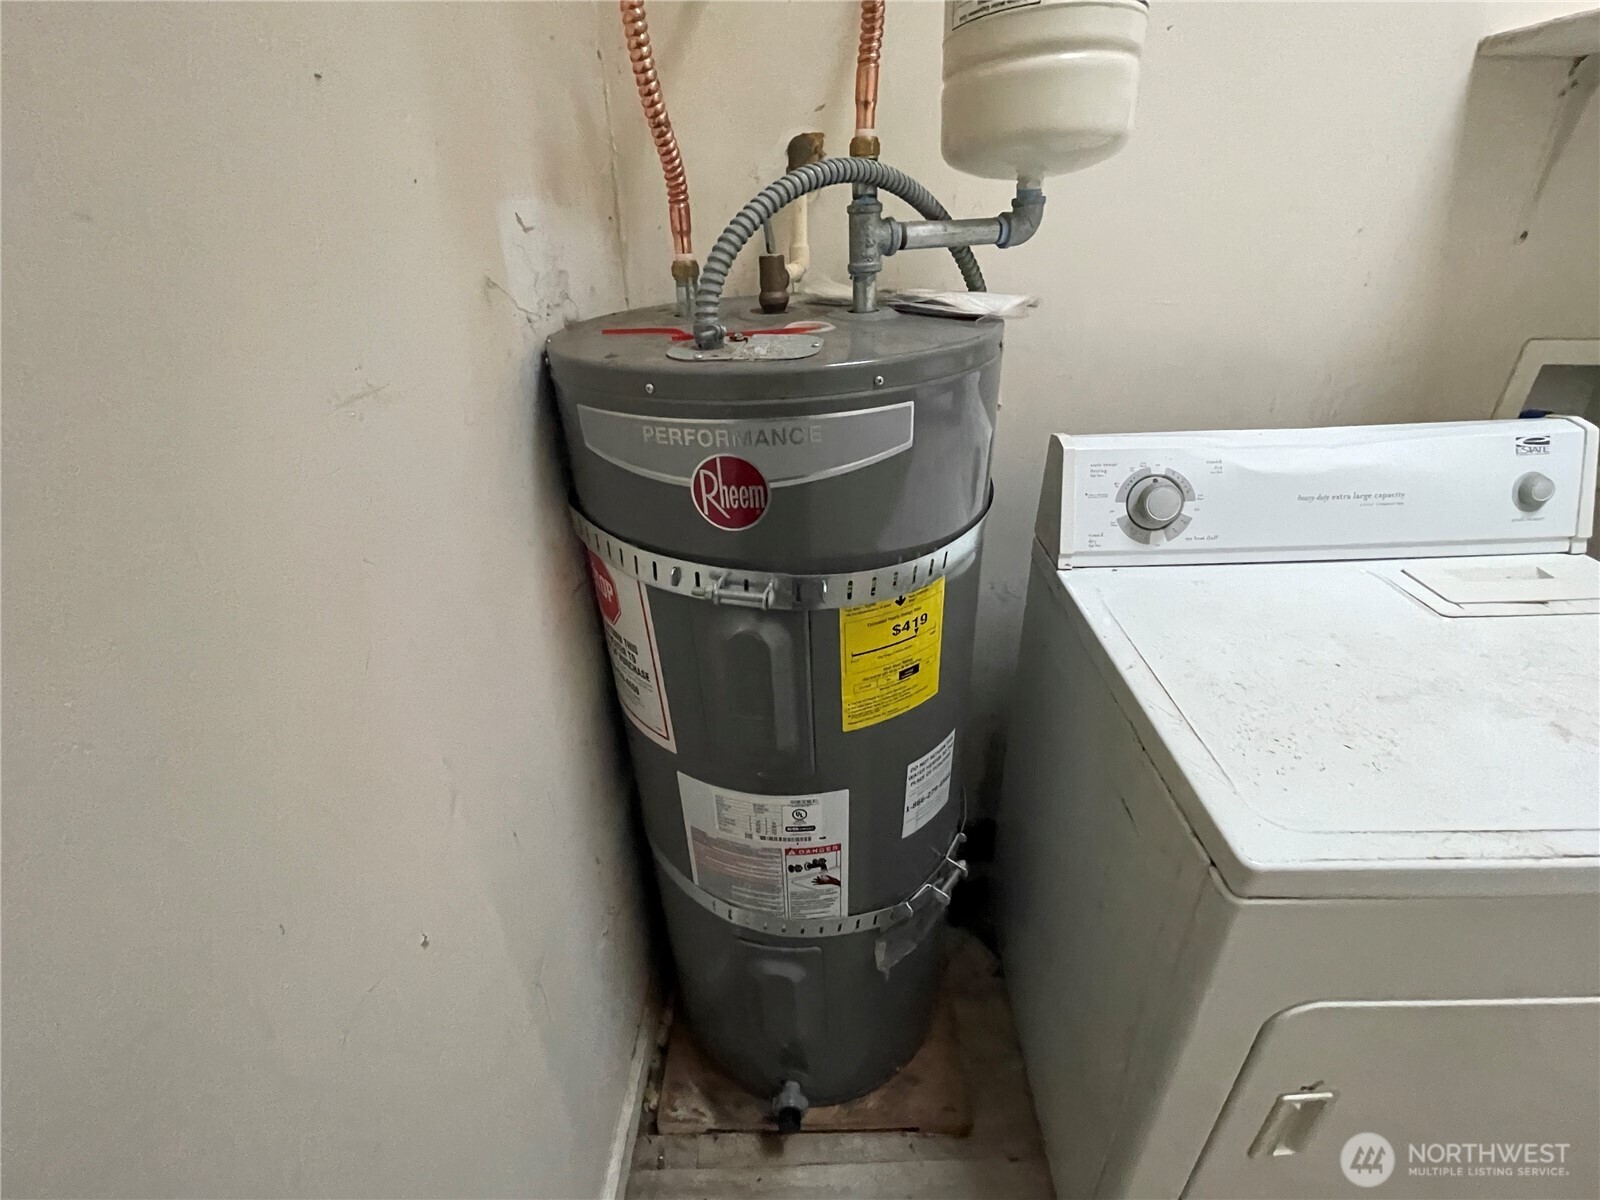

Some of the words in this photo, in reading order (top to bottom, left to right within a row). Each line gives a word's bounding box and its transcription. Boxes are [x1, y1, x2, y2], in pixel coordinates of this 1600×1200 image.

[642, 424, 822, 448] PERFORMANCE
[699, 457, 766, 519] Rheem
[1316, 493, 1330, 503] duty
[1353, 491, 1371, 501] large
[1374, 491, 1405, 501] capacity
[892, 613, 928, 637] $419
[910, 765, 919, 773] DO
[919, 755, 930, 769] NOT
[908, 766, 926, 781] WATER
[910, 773, 925, 787] PLACE
[798, 845, 838, 855] DANGER
